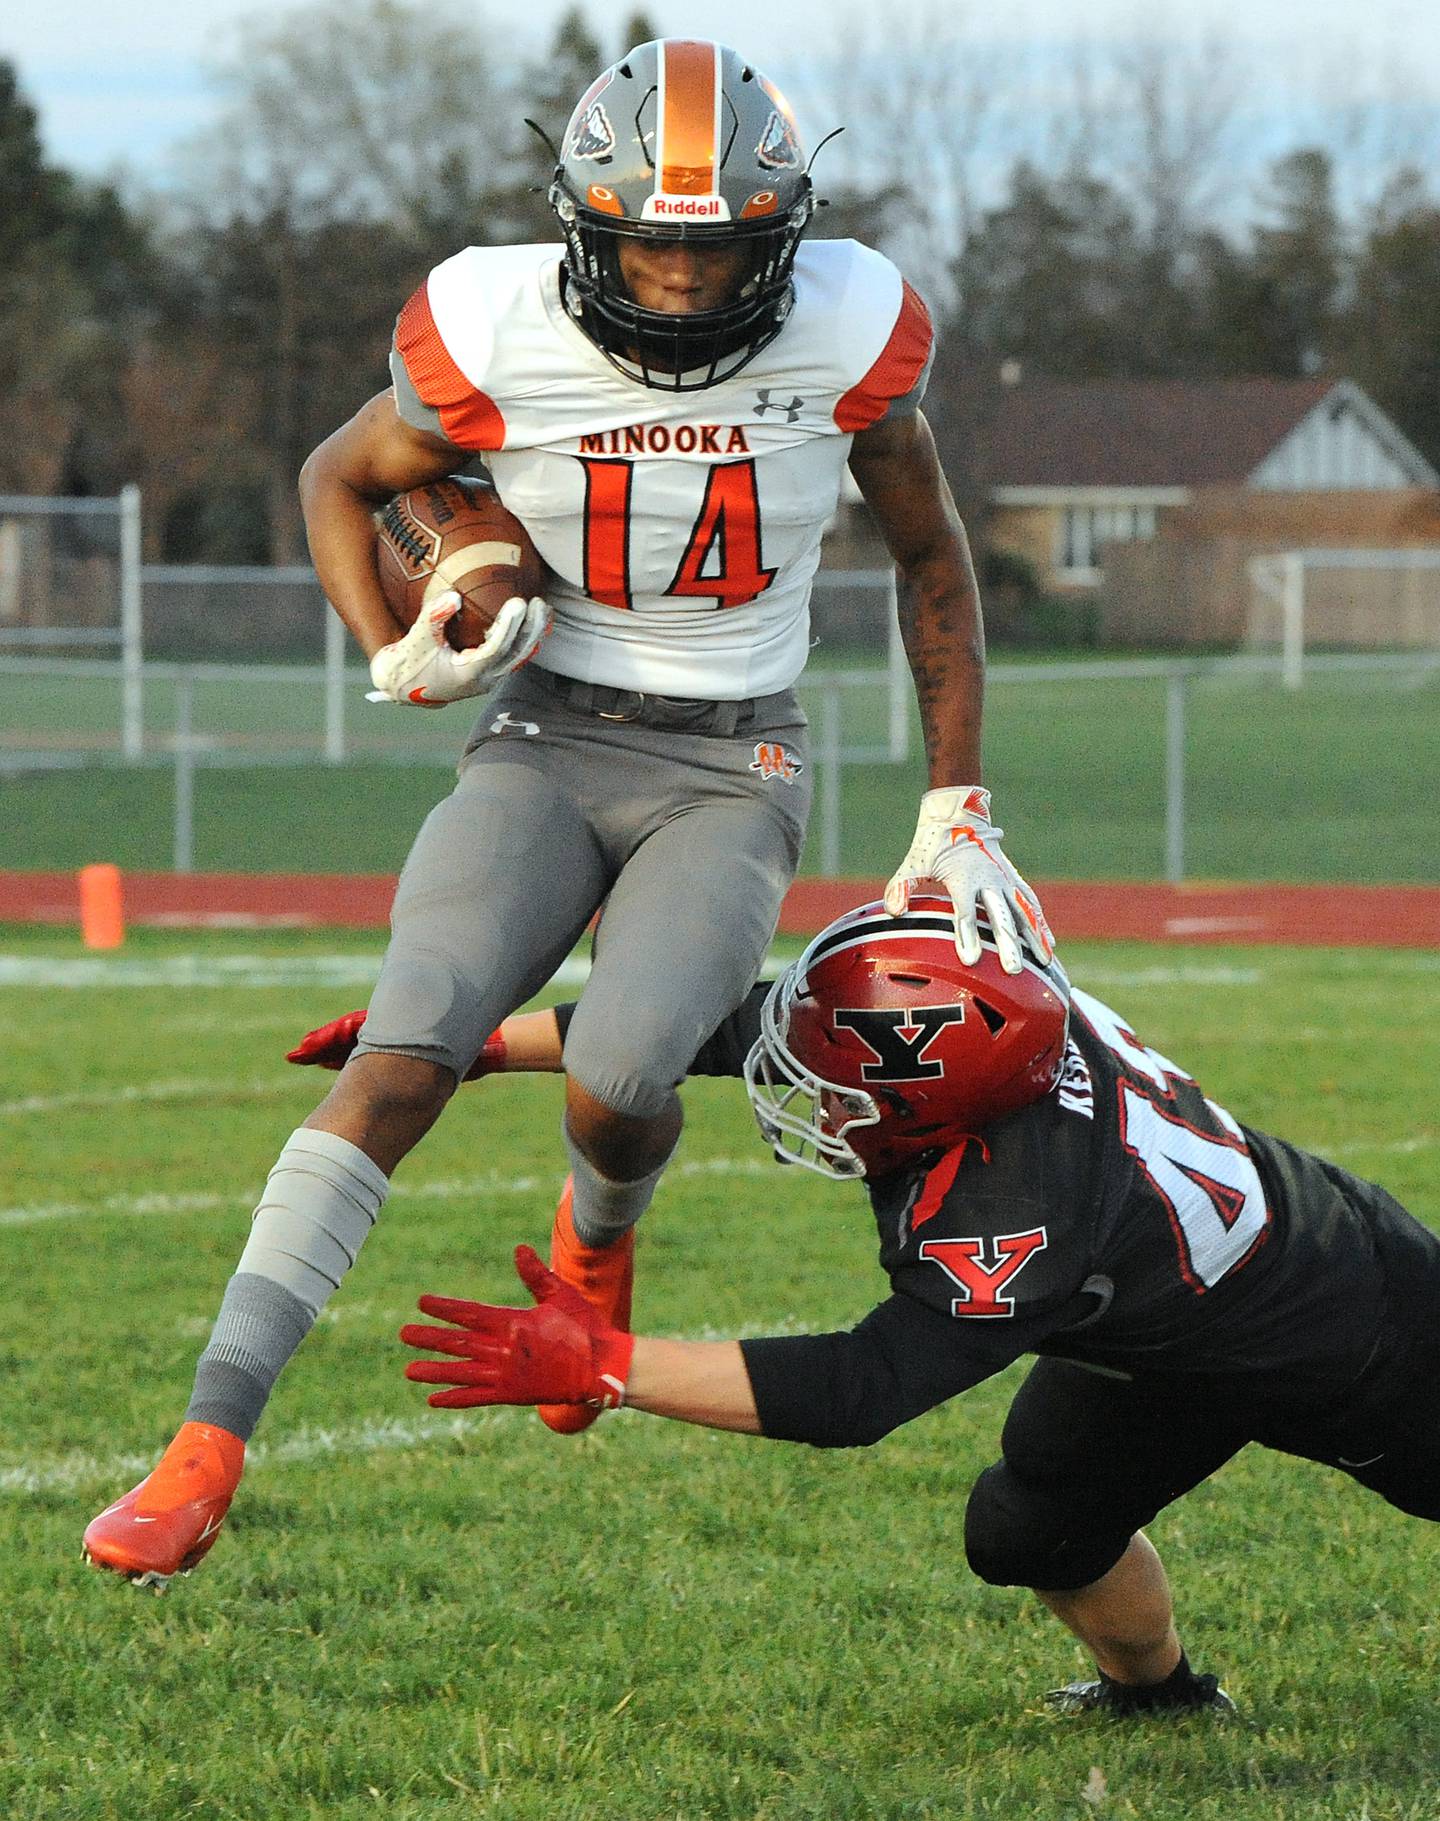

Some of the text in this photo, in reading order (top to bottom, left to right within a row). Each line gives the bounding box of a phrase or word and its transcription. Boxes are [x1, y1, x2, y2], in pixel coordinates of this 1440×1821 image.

[654, 200, 719, 216] Riddell
[579, 424, 750, 454] MINOOKA
[576, 457, 780, 612] 14
[833, 1003, 965, 1083] Y
[919, 1226, 1048, 1318] Y
